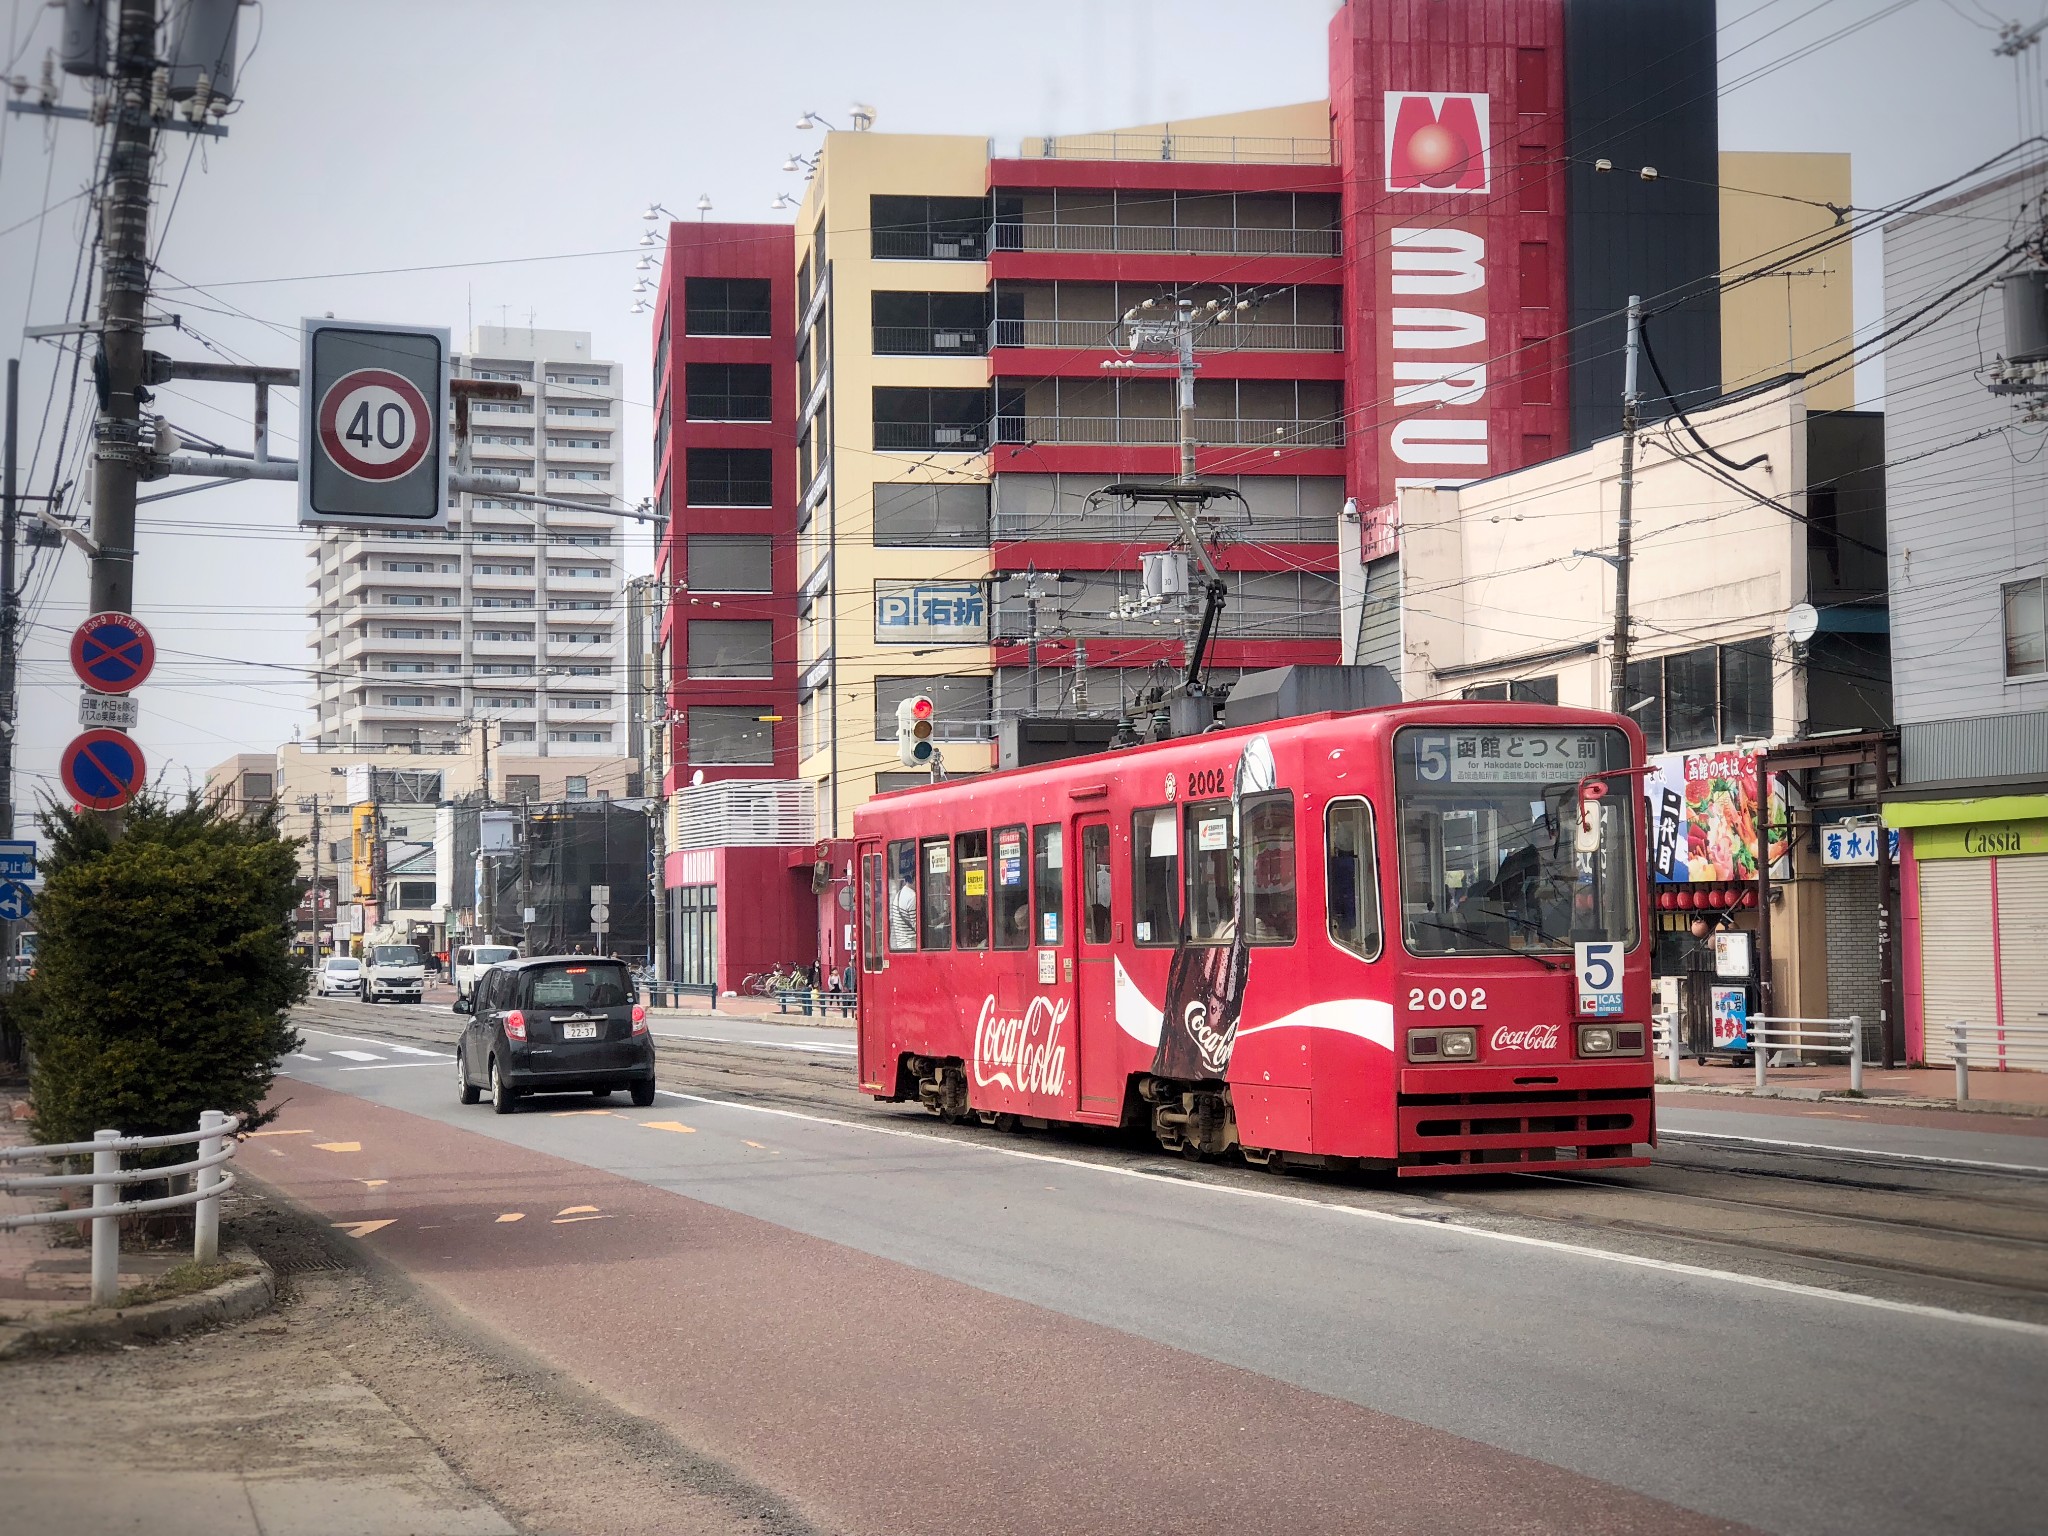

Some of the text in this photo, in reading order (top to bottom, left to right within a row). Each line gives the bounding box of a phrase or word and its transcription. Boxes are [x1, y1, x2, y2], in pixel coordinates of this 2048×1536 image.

[1390, 227, 1489, 489] MARU
[345, 400, 406, 450] 40
[922, 597, 984, 627] 右折
[80, 615, 145, 638] 7:30-9 17-18:30
[81, 698, 136, 713] 日曜・休日を除く
[81, 710, 135, 724] バスの乗降を除く
[1420, 736, 1597, 781] 5 函館どつく前
[1468, 761, 1587, 770] for Hakodate Dock-mae (D23)
[1688, 756, 1758, 780] 函館の味は、こ
[1188, 768, 1225, 797] 2002
[1659, 793, 1680, 875] 二代目
[1964, 826, 2022, 854] Cassia
[1584, 945, 1614, 990] 5
[1408, 987, 1488, 1011] 2002
[1598, 994, 1622, 1005] ICAS
[571, 1028, 594, 1037] 22-37
[1490, 1024, 1562, 1051] Coca-Cola
[1714, 1018, 1746, 1039] 昌栄丸
[974, 993, 1071, 1096] Coca-Cola
